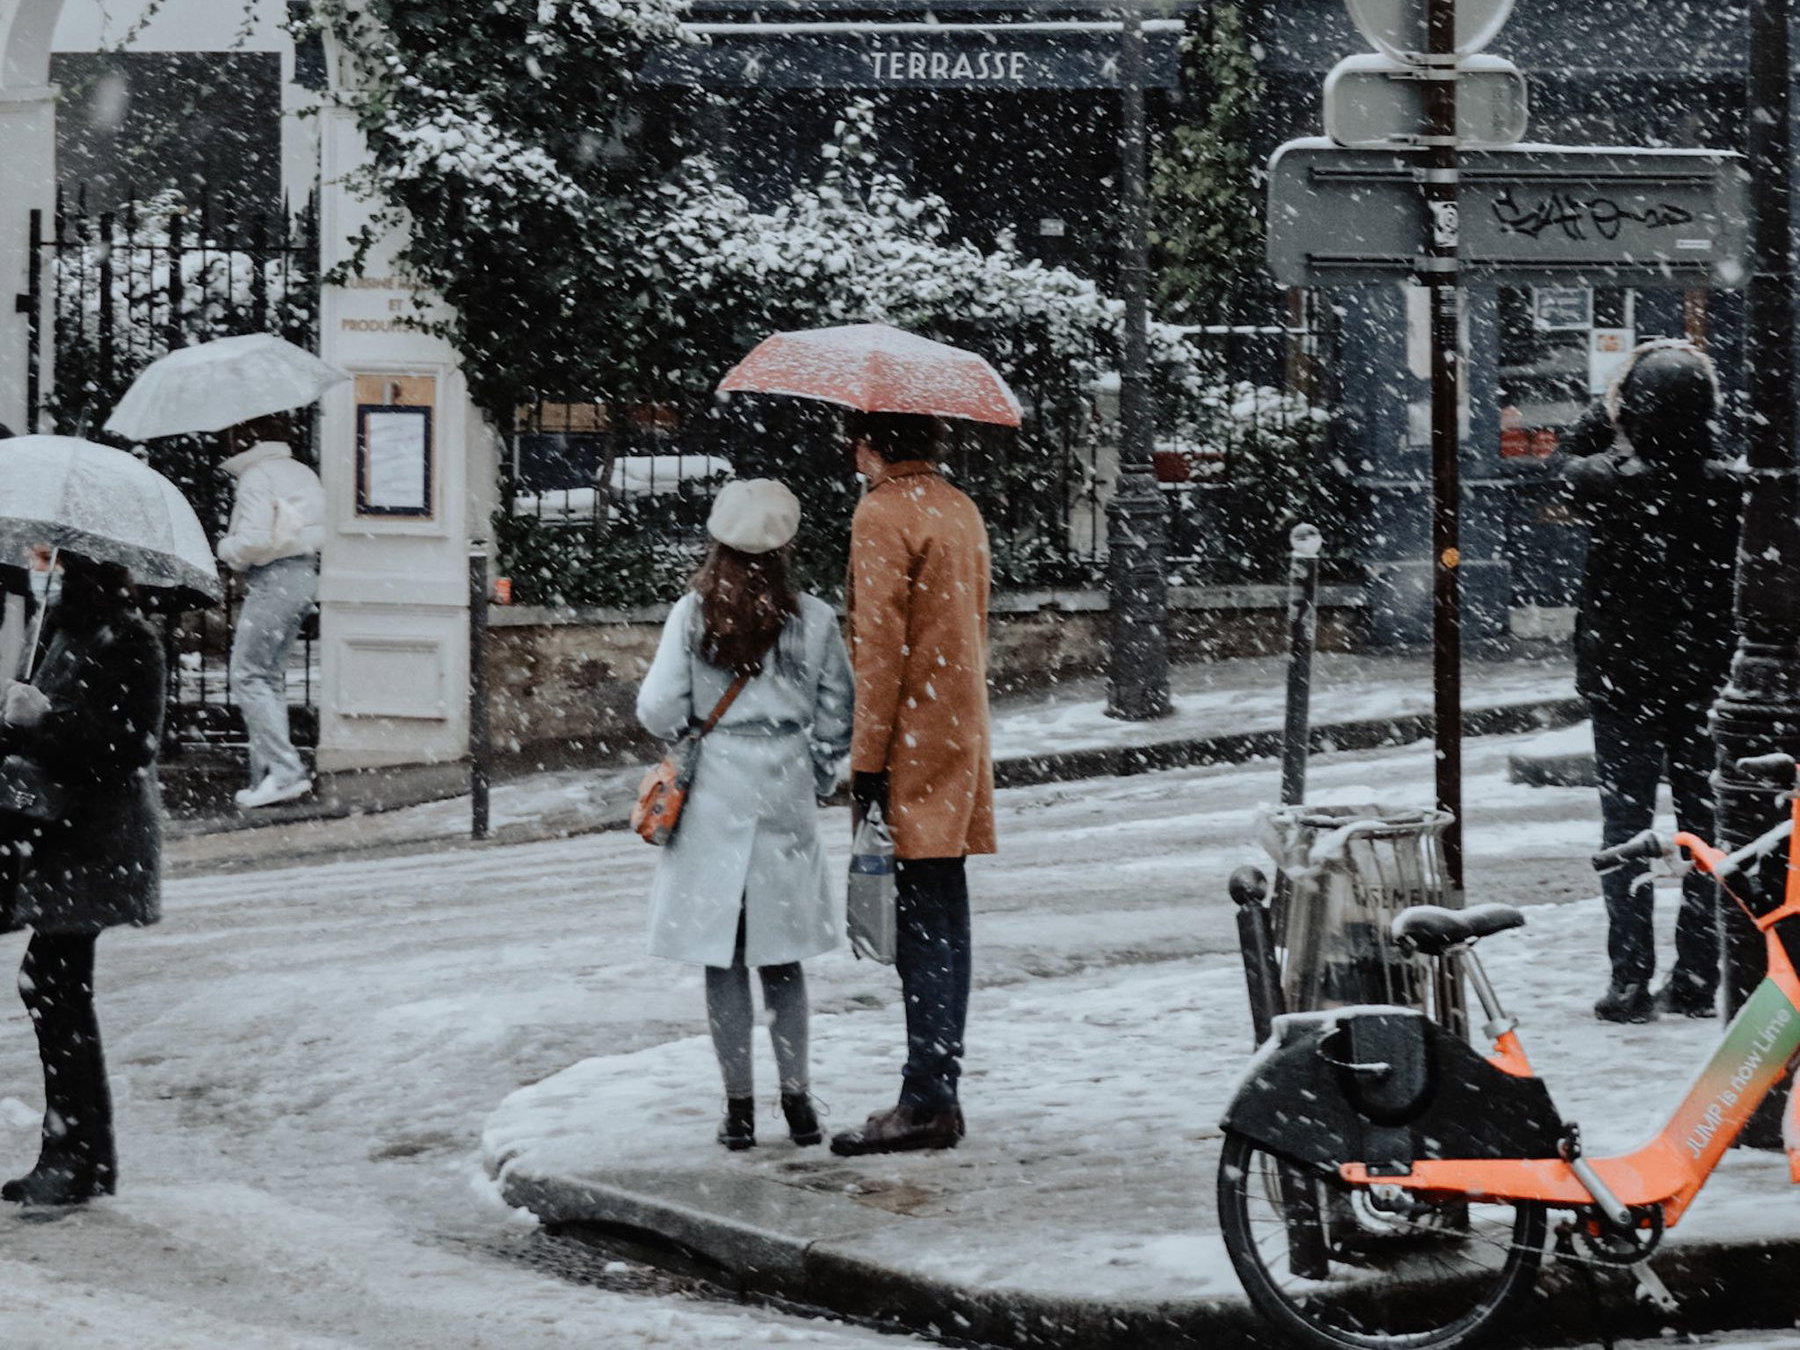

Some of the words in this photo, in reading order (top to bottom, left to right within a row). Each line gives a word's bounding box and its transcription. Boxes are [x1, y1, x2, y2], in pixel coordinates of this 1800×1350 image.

[869, 51, 1026, 79] TERRASSE
[388, 299, 403, 311] ET
[341, 318, 410, 332] PRODUS
[1687, 1103, 1722, 1159] JUMP
[1717, 1090, 1738, 1107] is
[1731, 1050, 1763, 1093] now
[1752, 1008, 1792, 1053] Lime
